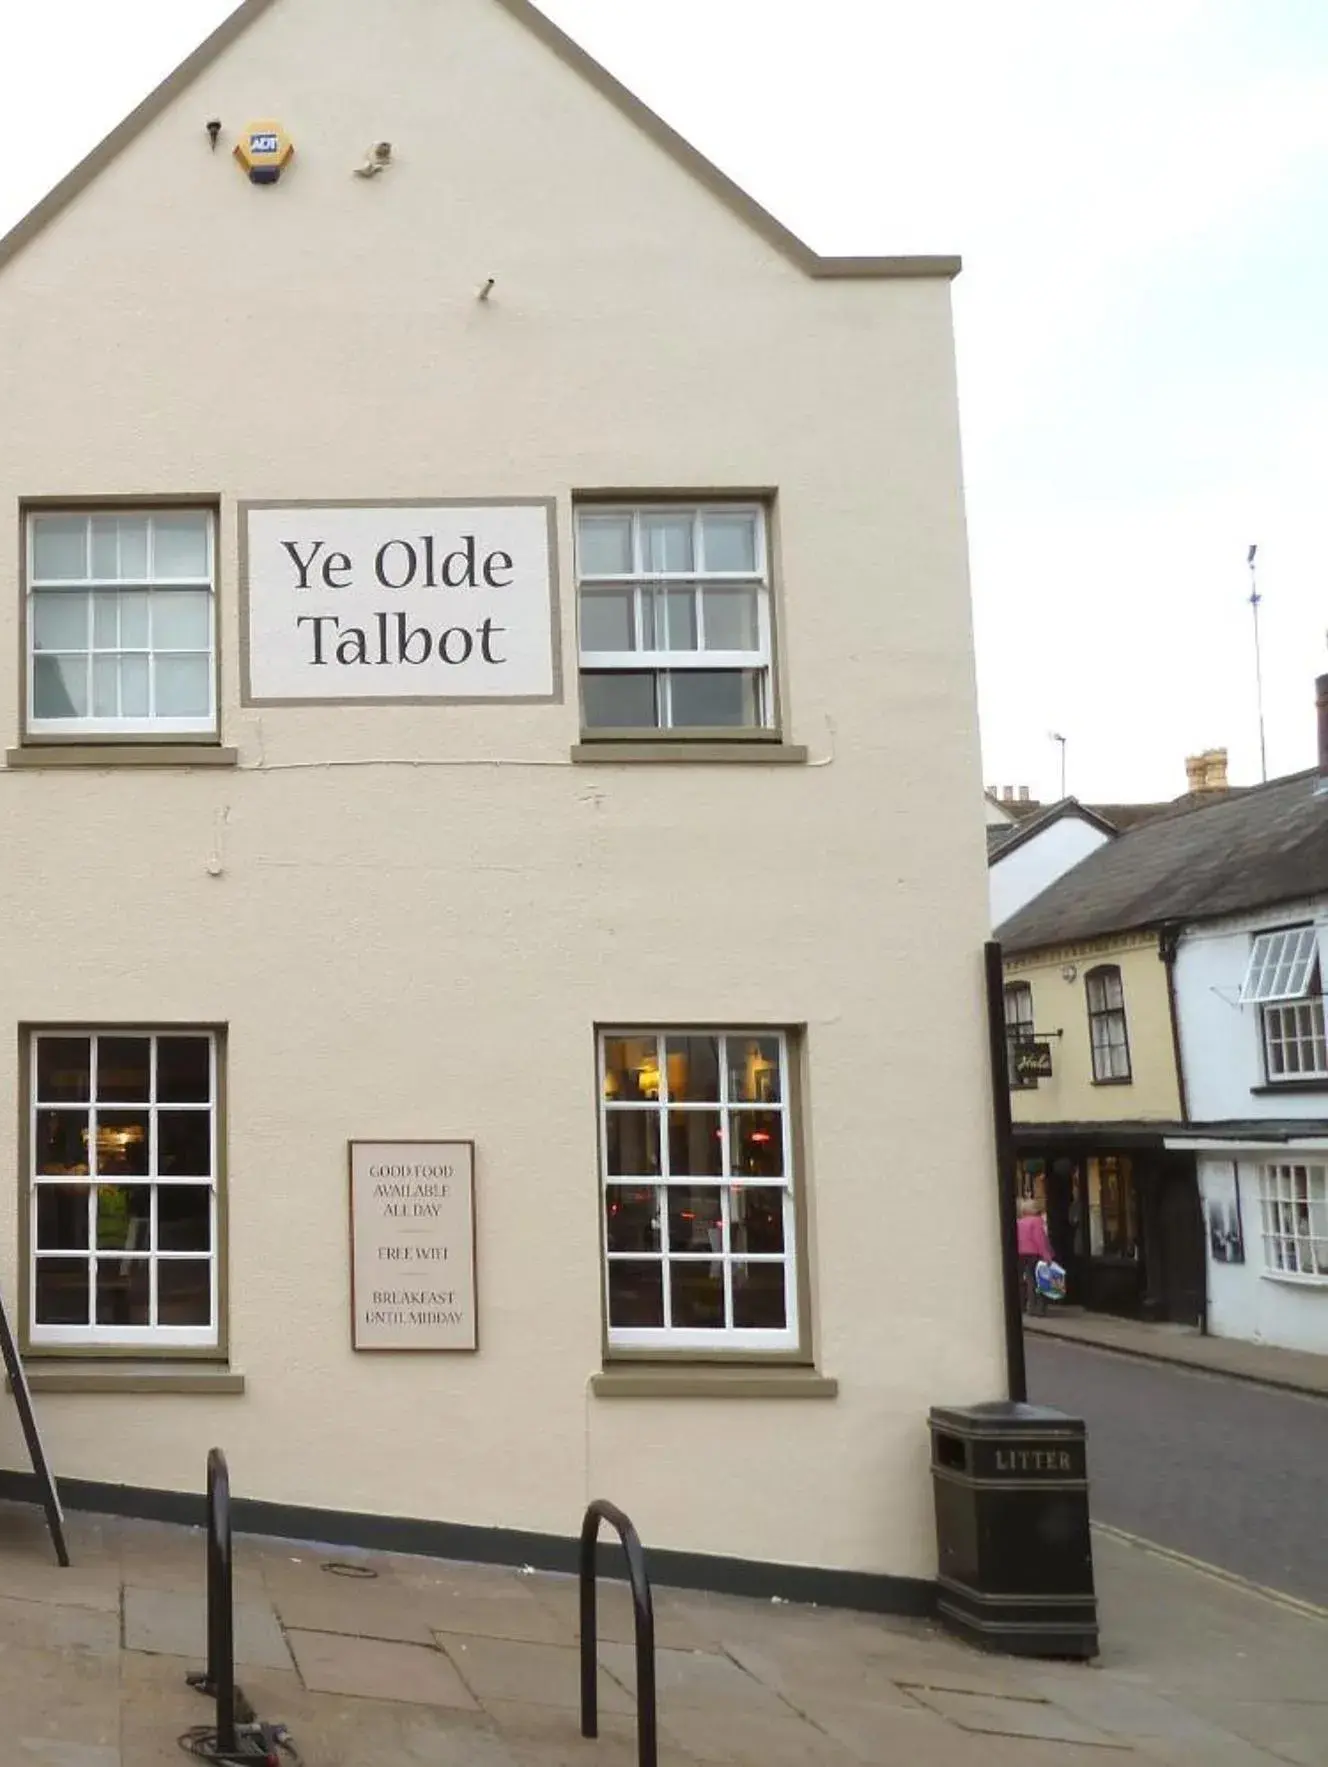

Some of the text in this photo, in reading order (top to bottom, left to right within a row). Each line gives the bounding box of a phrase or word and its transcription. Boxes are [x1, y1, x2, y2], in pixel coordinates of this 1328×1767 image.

[253, 137, 275, 150] ADT
[280, 535, 514, 588] Ye Olde
[297, 612, 506, 664] Talbot
[369, 1165, 454, 1177] GOOD FOOD
[374, 1183, 450, 1197] AVAILABLE
[384, 1203, 442, 1217] ALL DAY
[378, 1247, 412, 1260] FREE
[373, 1291, 454, 1304] BREAKFAST
[365, 1311, 462, 1325] UNTIL MIDDAY
[996, 1450, 1070, 1470] LITTER
